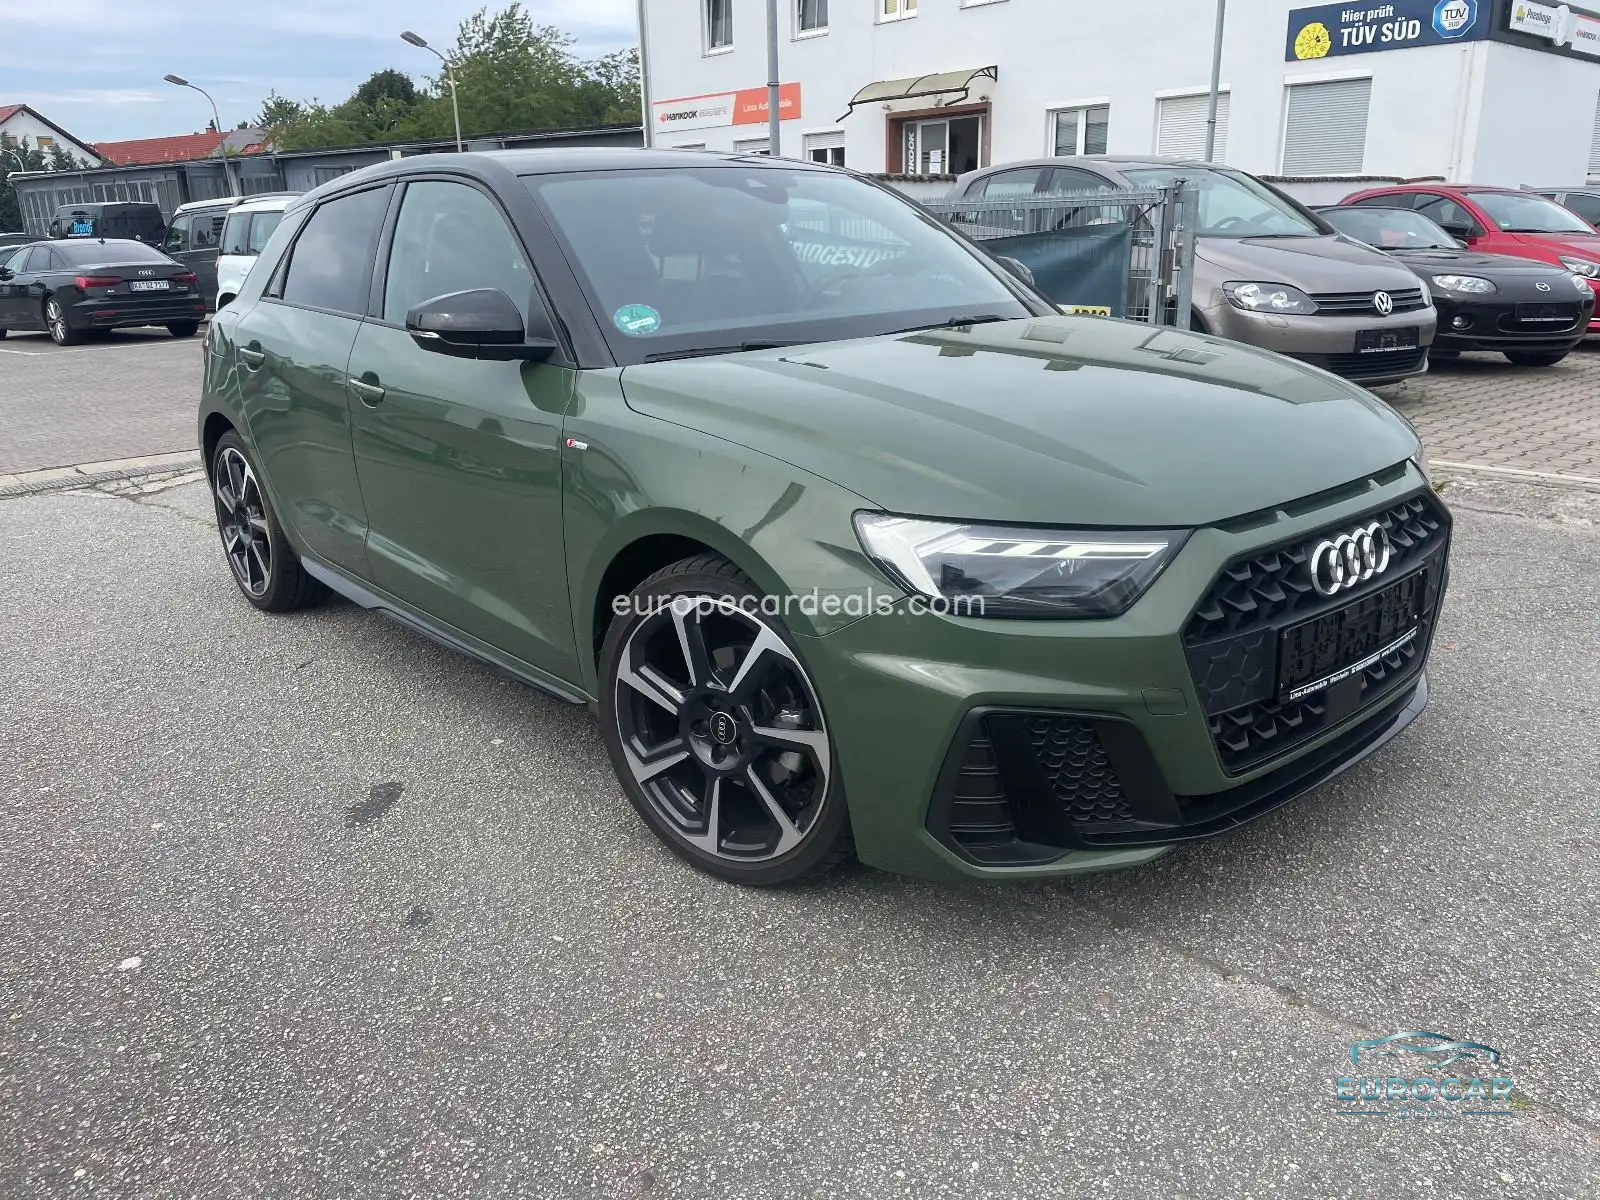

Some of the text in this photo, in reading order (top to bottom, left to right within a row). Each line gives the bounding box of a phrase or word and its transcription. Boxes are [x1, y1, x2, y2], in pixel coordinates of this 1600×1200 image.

[1341, 4, 1394, 22] Hier prüft
[1340, 22, 1377, 47] TÜV
[1380, 17, 1421, 42] SÜD
[793, 241, 907, 270] RIDGESTO
